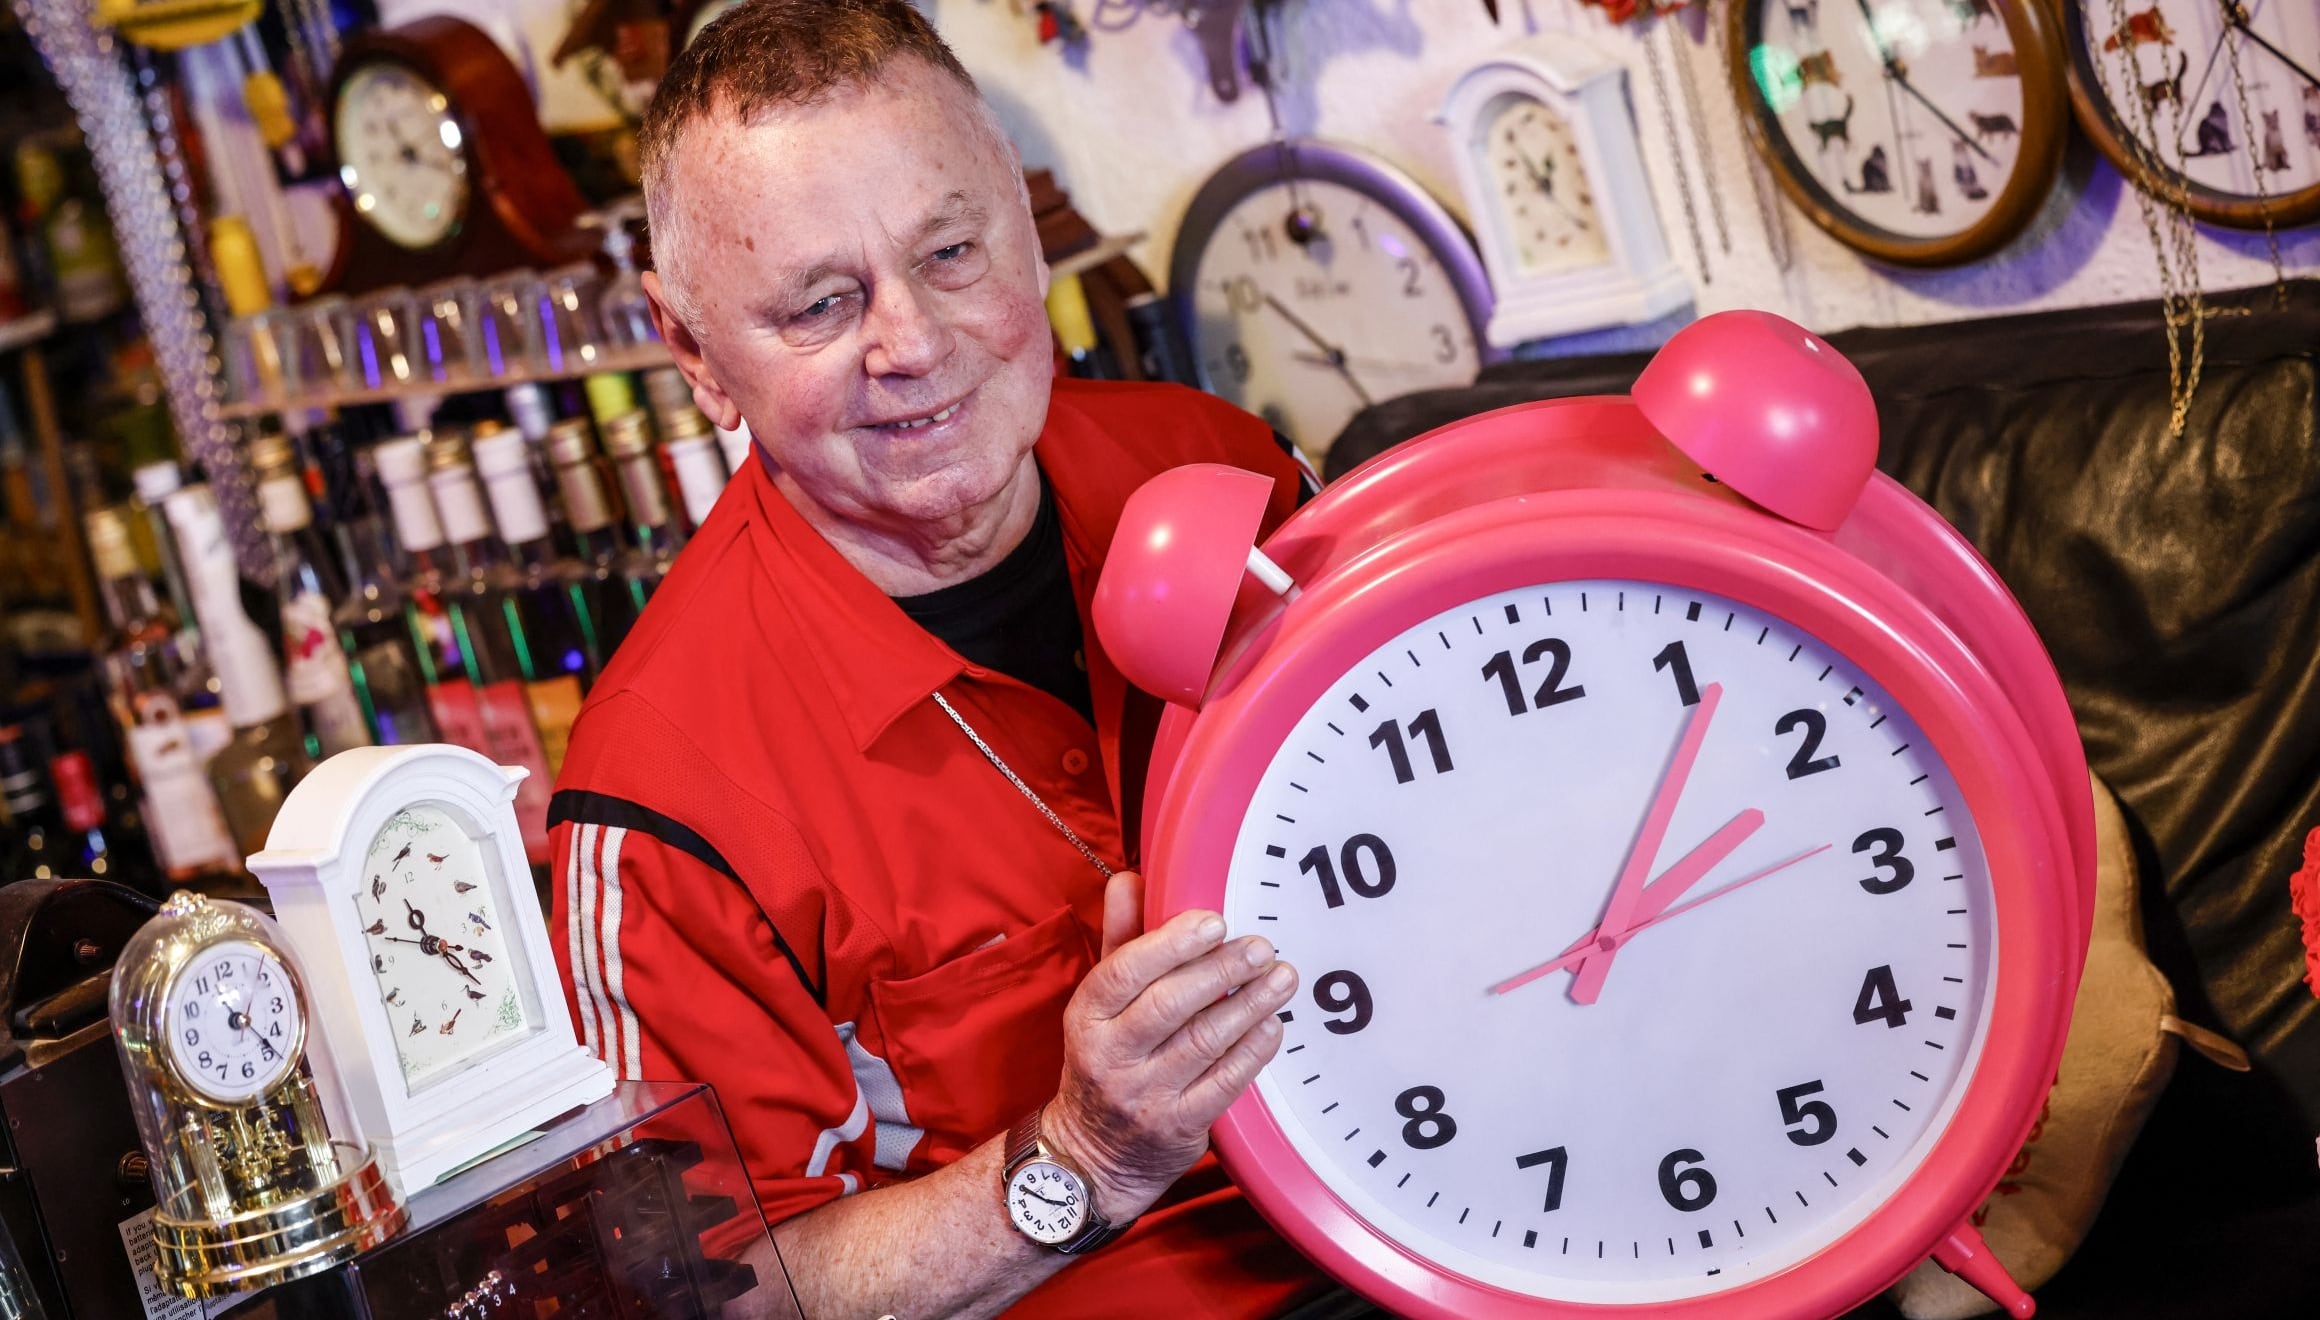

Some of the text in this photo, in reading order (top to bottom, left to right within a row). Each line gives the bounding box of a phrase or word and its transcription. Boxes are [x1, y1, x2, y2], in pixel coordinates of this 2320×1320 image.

[1397, 258, 1422, 298] 2
[1431, 323, 1458, 365] 3
[1482, 638, 1585, 716] 12
[1653, 640, 1701, 706] 1
[1368, 708, 1454, 784] 11
[1774, 708, 1841, 780] 2
[1851, 827, 1915, 895] 3
[404, 871, 415, 884] 12
[1298, 833, 1397, 909] 10
[461, 922, 468, 935] 3
[388, 955, 395, 966] 9
[214, 961, 234, 982] 12
[257, 972, 271, 988] 2
[195, 977, 210, 996] 11
[1312, 969, 1374, 1035] 9
[1852, 964, 1913, 1029] 4
[184, 1001, 200, 1020] 10
[271, 997, 284, 1014] 3
[441, 1001, 448, 1012] 6
[185, 1028, 200, 1047] 9
[270, 1021, 283, 1038] 4
[199, 1050, 213, 1069] 8
[261, 1045, 275, 1062] 5
[216, 1063, 229, 1080] 7
[242, 1062, 255, 1079] 6
[1394, 1085, 1457, 1150] 8
[1776, 1079, 1838, 1147] 5
[1027, 1173, 1036, 1183] 6
[1041, 1168, 1050, 1181] 7
[1052, 1172, 1062, 1182] 8
[1515, 1146, 1569, 1213] 7
[1657, 1148, 1718, 1212] 6
[1064, 1181, 1073, 1191] 9
[1018, 1199, 1027, 1209] 4
[1066, 1192, 1079, 1206] 10
[1024, 1211, 1033, 1220] 3
[1067, 1207, 1077, 1218] 11
[133, 1222, 146, 1234] you
[1034, 1219, 1045, 1231] 2
[1048, 1223, 1056, 1233] 1
[1058, 1216, 1072, 1230] 12
[135, 1252, 152, 1266] back
[479, 1305, 487, 1317] 2
[493, 1294, 502, 1307] 3
[509, 1282, 516, 1296] 4
